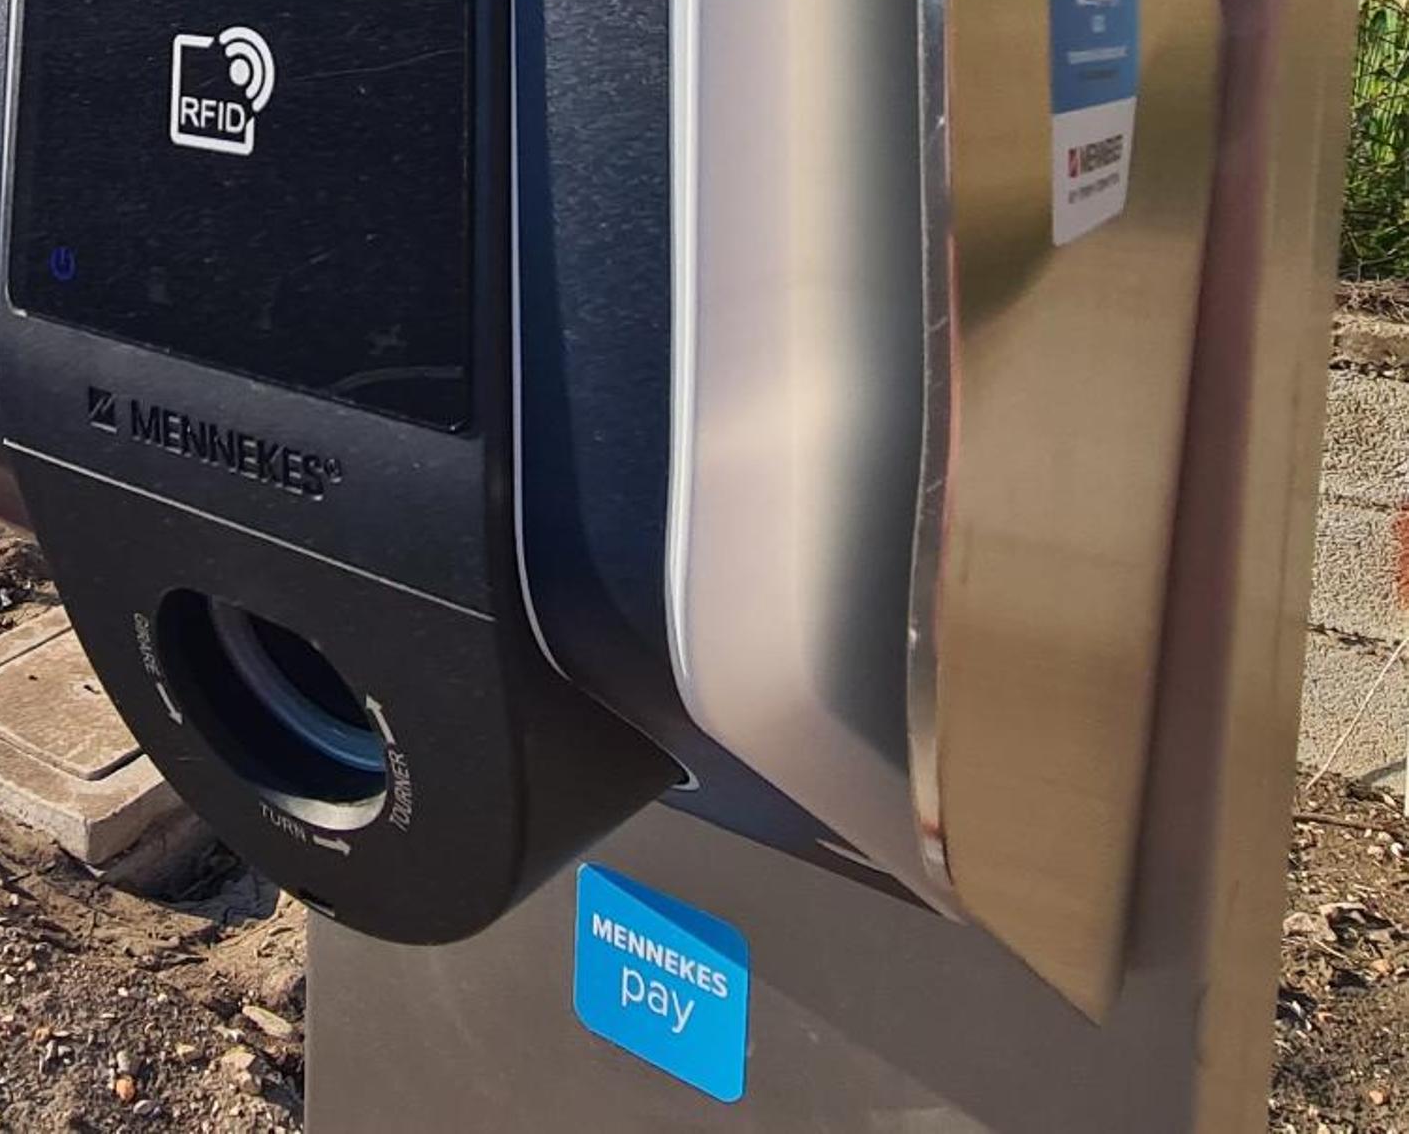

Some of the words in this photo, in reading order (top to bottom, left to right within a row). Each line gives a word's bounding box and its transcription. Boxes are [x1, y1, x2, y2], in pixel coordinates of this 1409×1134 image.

[180, 96, 246, 134] RFID
[259, 803, 308, 843] TURN
[389, 748, 412, 832] TOURNER
[592, 912, 728, 999] MENNEKES
[621, 966, 695, 1034] pay
